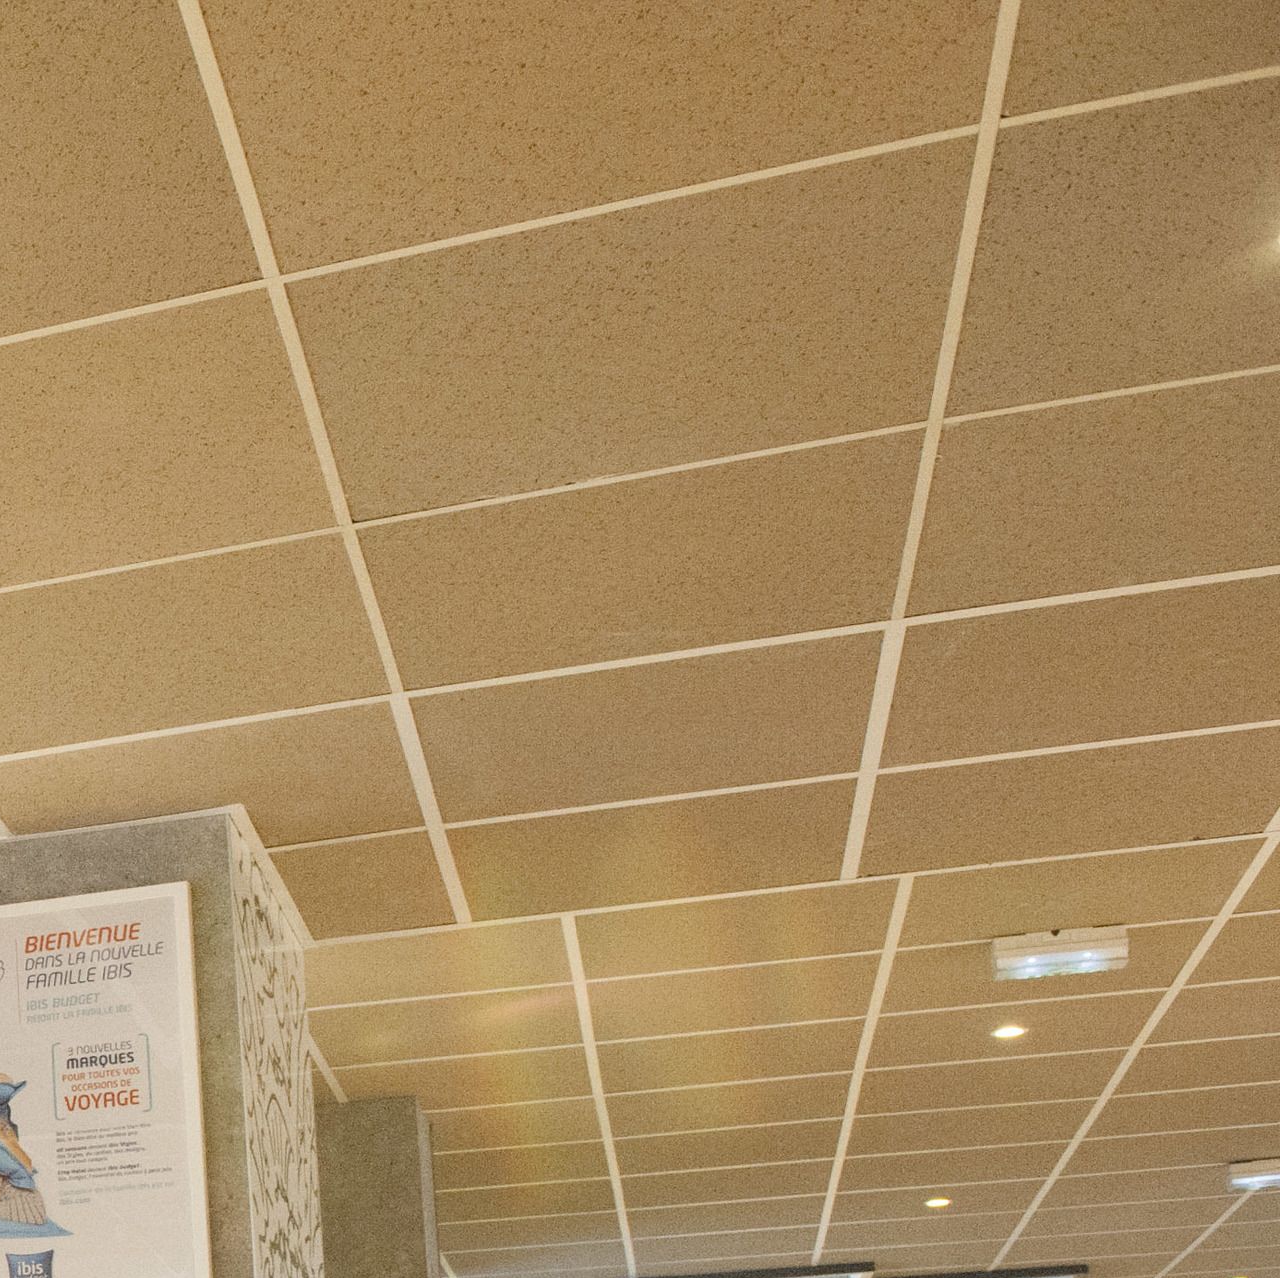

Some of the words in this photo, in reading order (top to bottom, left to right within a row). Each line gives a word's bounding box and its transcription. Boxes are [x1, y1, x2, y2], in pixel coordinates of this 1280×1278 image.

[24, 922, 142, 954] BIENVENUE
[25, 954, 63, 971] DANS
[68, 951, 86, 966] LA
[90, 941, 165, 963] NOUVELLE
[26, 967, 97, 990] FAMILLE
[102, 962, 134, 981] IBIS
[52, 992, 100, 1009] BUDGET
[76, 1040, 133, 1056] NOUVELLES
[66, 1052, 135, 1070] MARQUES
[62, 1072, 86, 1082] POUR
[88, 1068, 121, 1079] TOUTES
[123, 1066, 141, 1076] VOS
[71, 1079, 119, 1092] OCCASIONS
[120, 1078, 132, 1088] DE
[64, 1089, 140, 1112] VOYAGE
[16, 1261, 44, 1276] ibis
